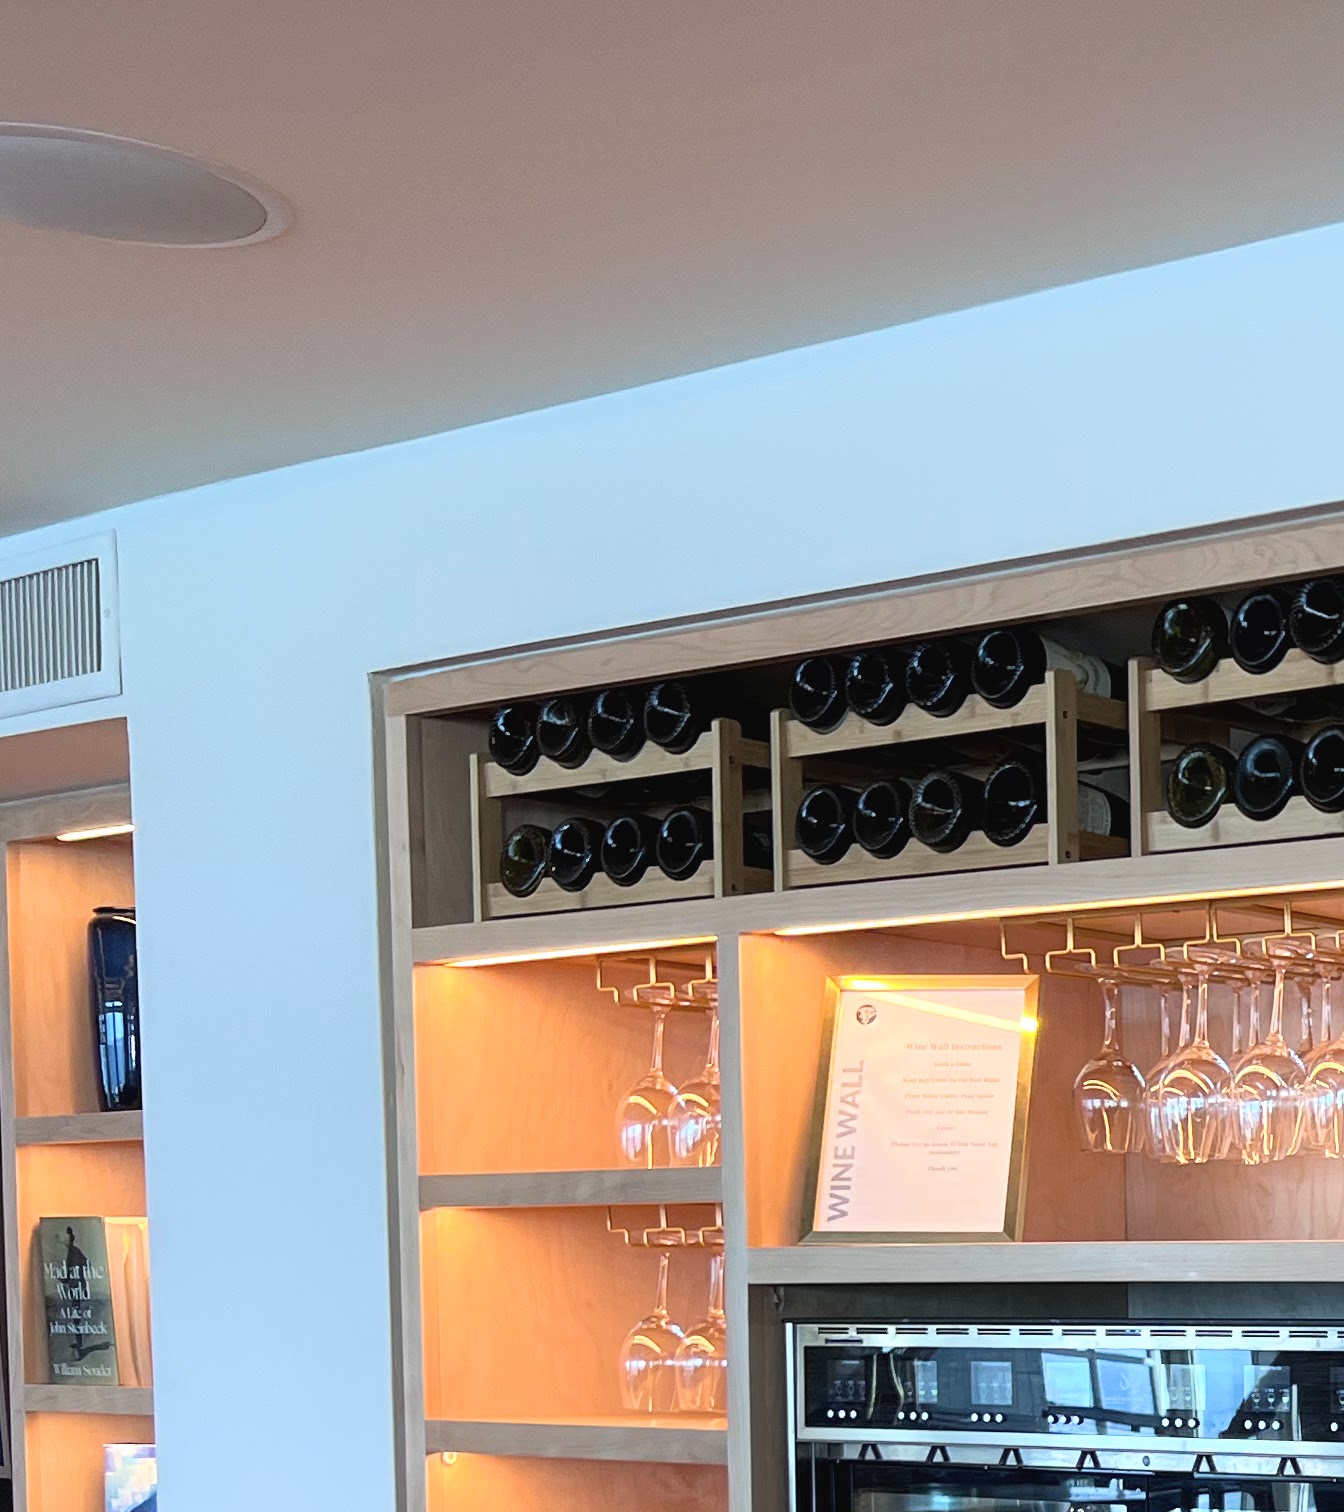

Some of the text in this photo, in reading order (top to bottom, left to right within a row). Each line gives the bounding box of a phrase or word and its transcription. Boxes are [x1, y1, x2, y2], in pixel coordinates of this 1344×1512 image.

[951, 1042, 1002, 1051] Instructions
[826, 1059, 865, 1223] WINE WALL
[43, 1258, 105, 1281] Mad at the
[56, 1281, 91, 1301] World
[59, 1307, 67, 1320] A
[83, 1305, 94, 1320] of
[50, 1320, 108, 1336] John Steinbeck
[53, 1362, 113, 1377] William Souder
